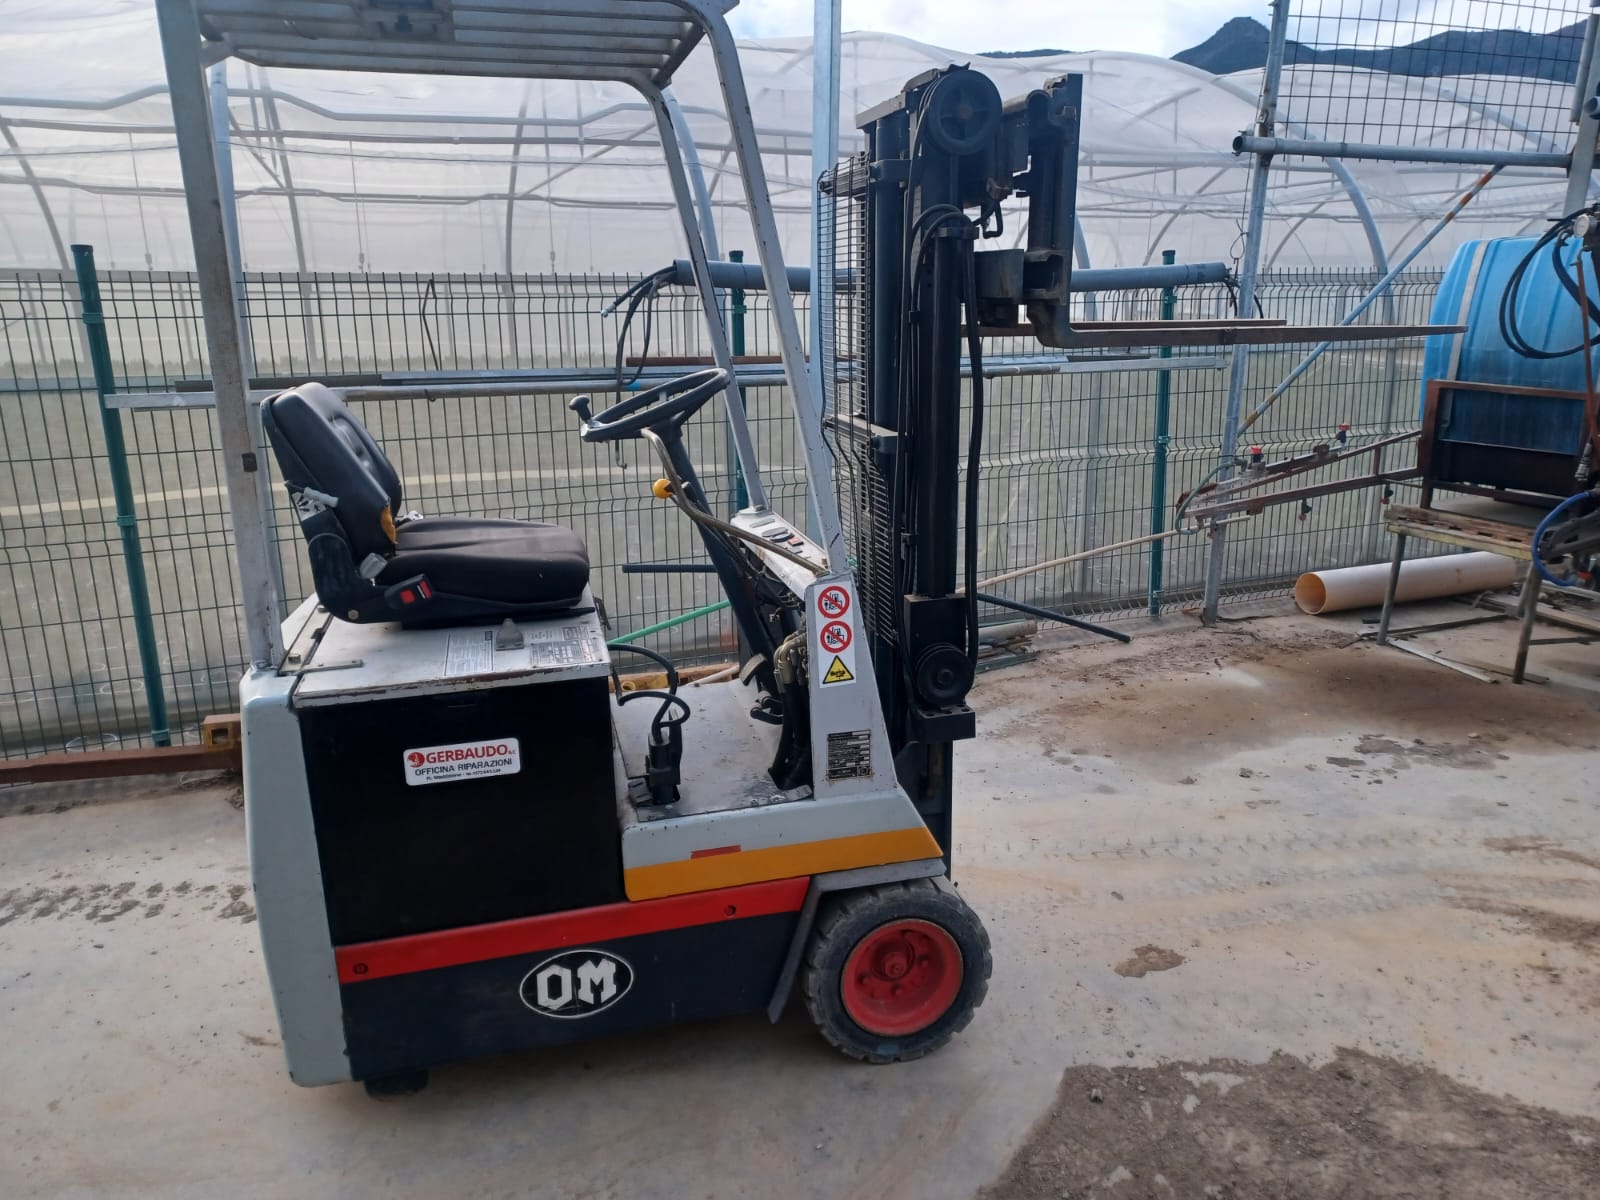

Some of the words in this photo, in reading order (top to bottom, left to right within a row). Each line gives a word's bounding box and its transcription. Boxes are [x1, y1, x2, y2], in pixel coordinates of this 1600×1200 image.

[426, 744, 508, 764] GERBAUDO
[415, 765, 455, 776] OFFICINA
[458, 758, 512, 771] RIPARAZIONI
[537, 958, 617, 1010] OM
